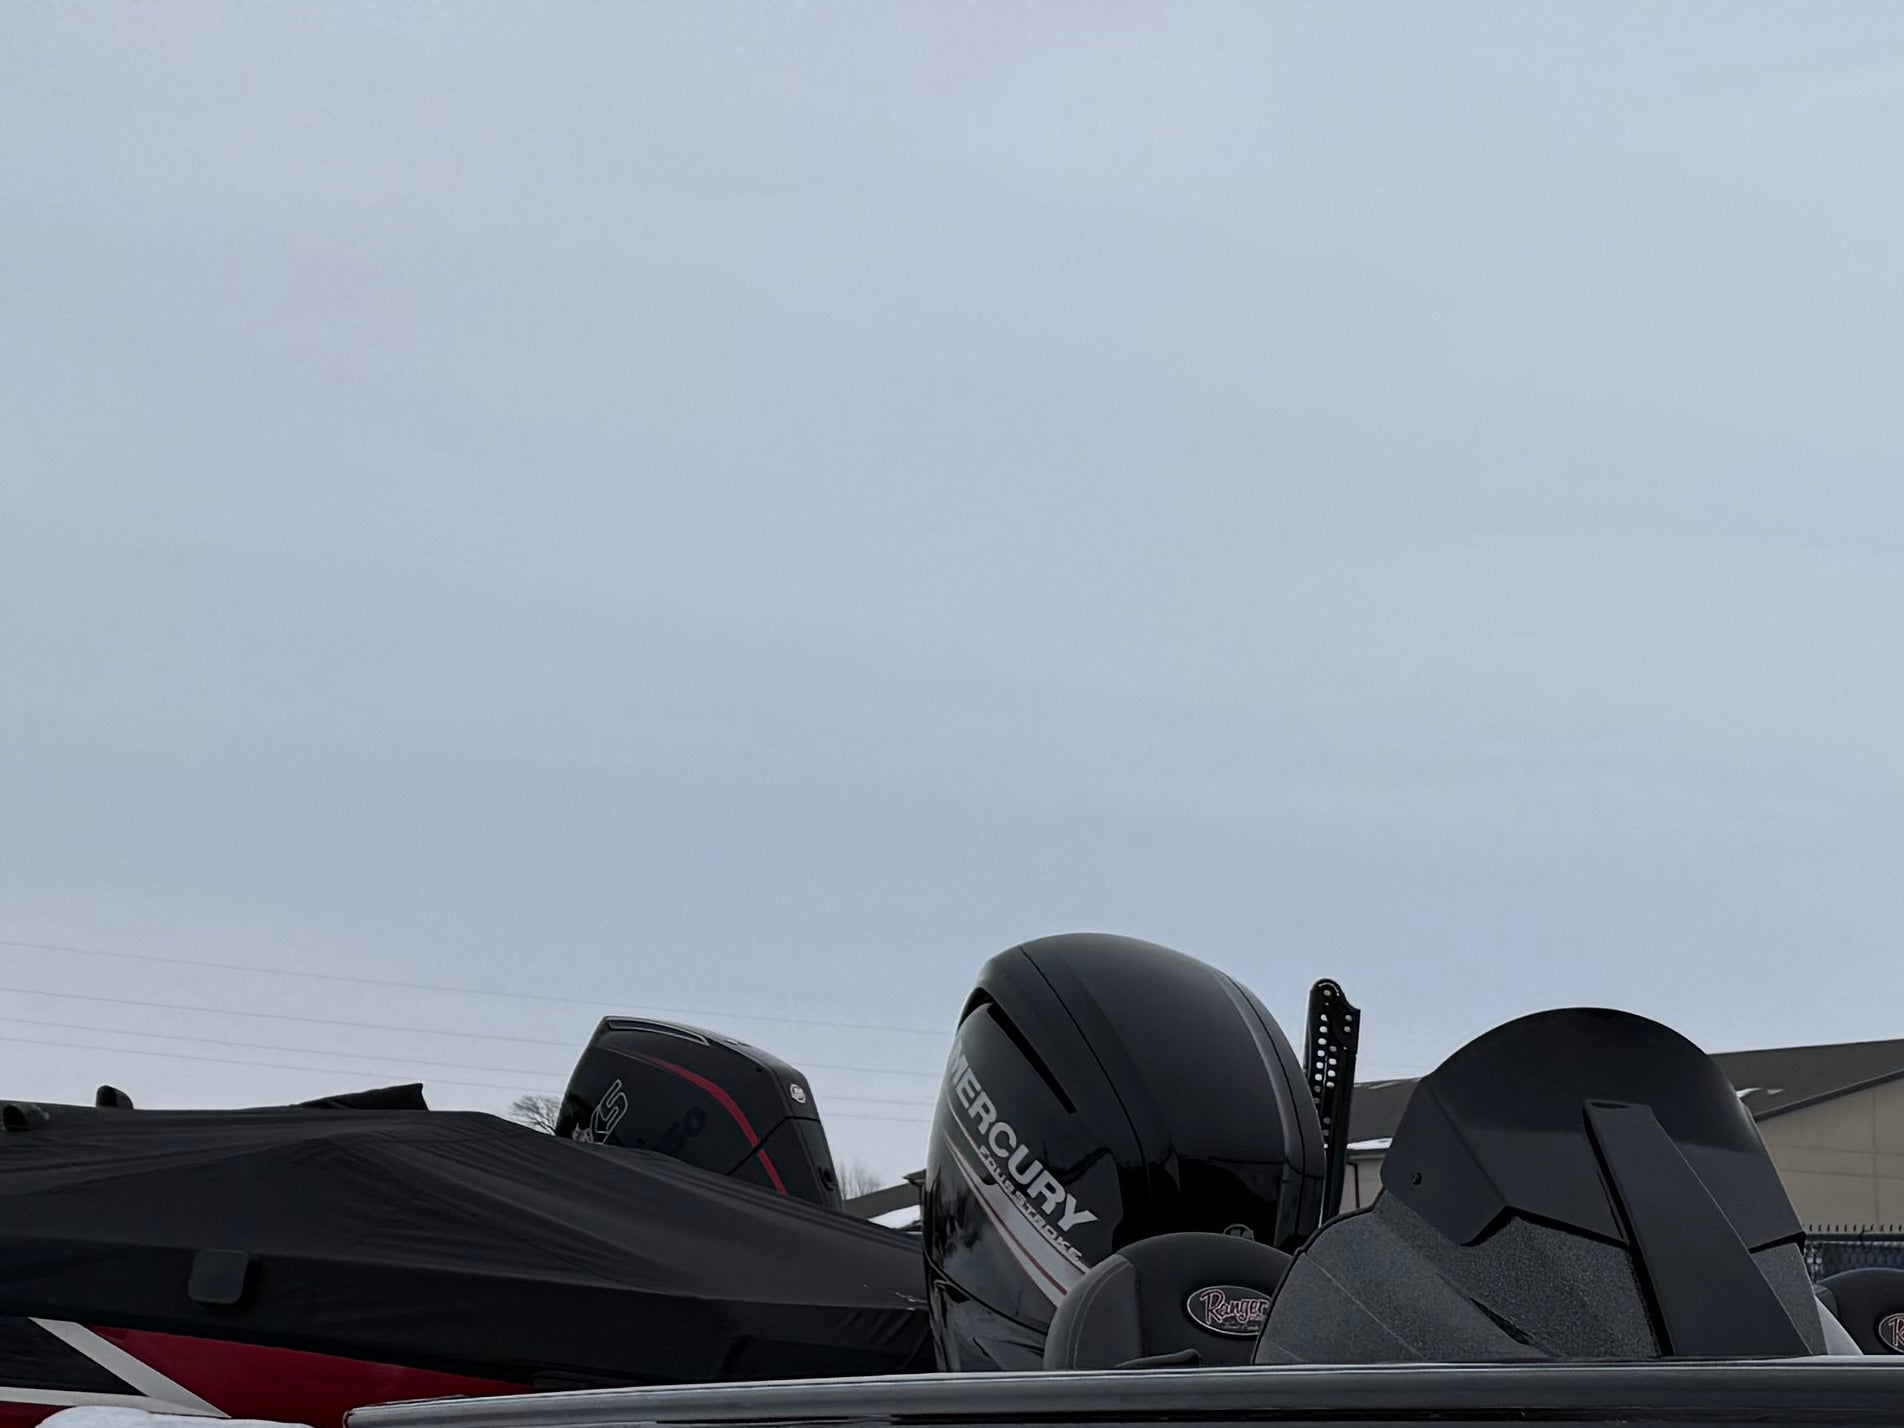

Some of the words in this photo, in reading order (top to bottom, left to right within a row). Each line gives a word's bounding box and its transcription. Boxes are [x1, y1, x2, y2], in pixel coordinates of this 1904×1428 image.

[949, 1036, 1099, 1232] MERCURY
[979, 1145, 1083, 1262] FOURSTROKE
[1200, 1288, 1270, 1325] Ranger
